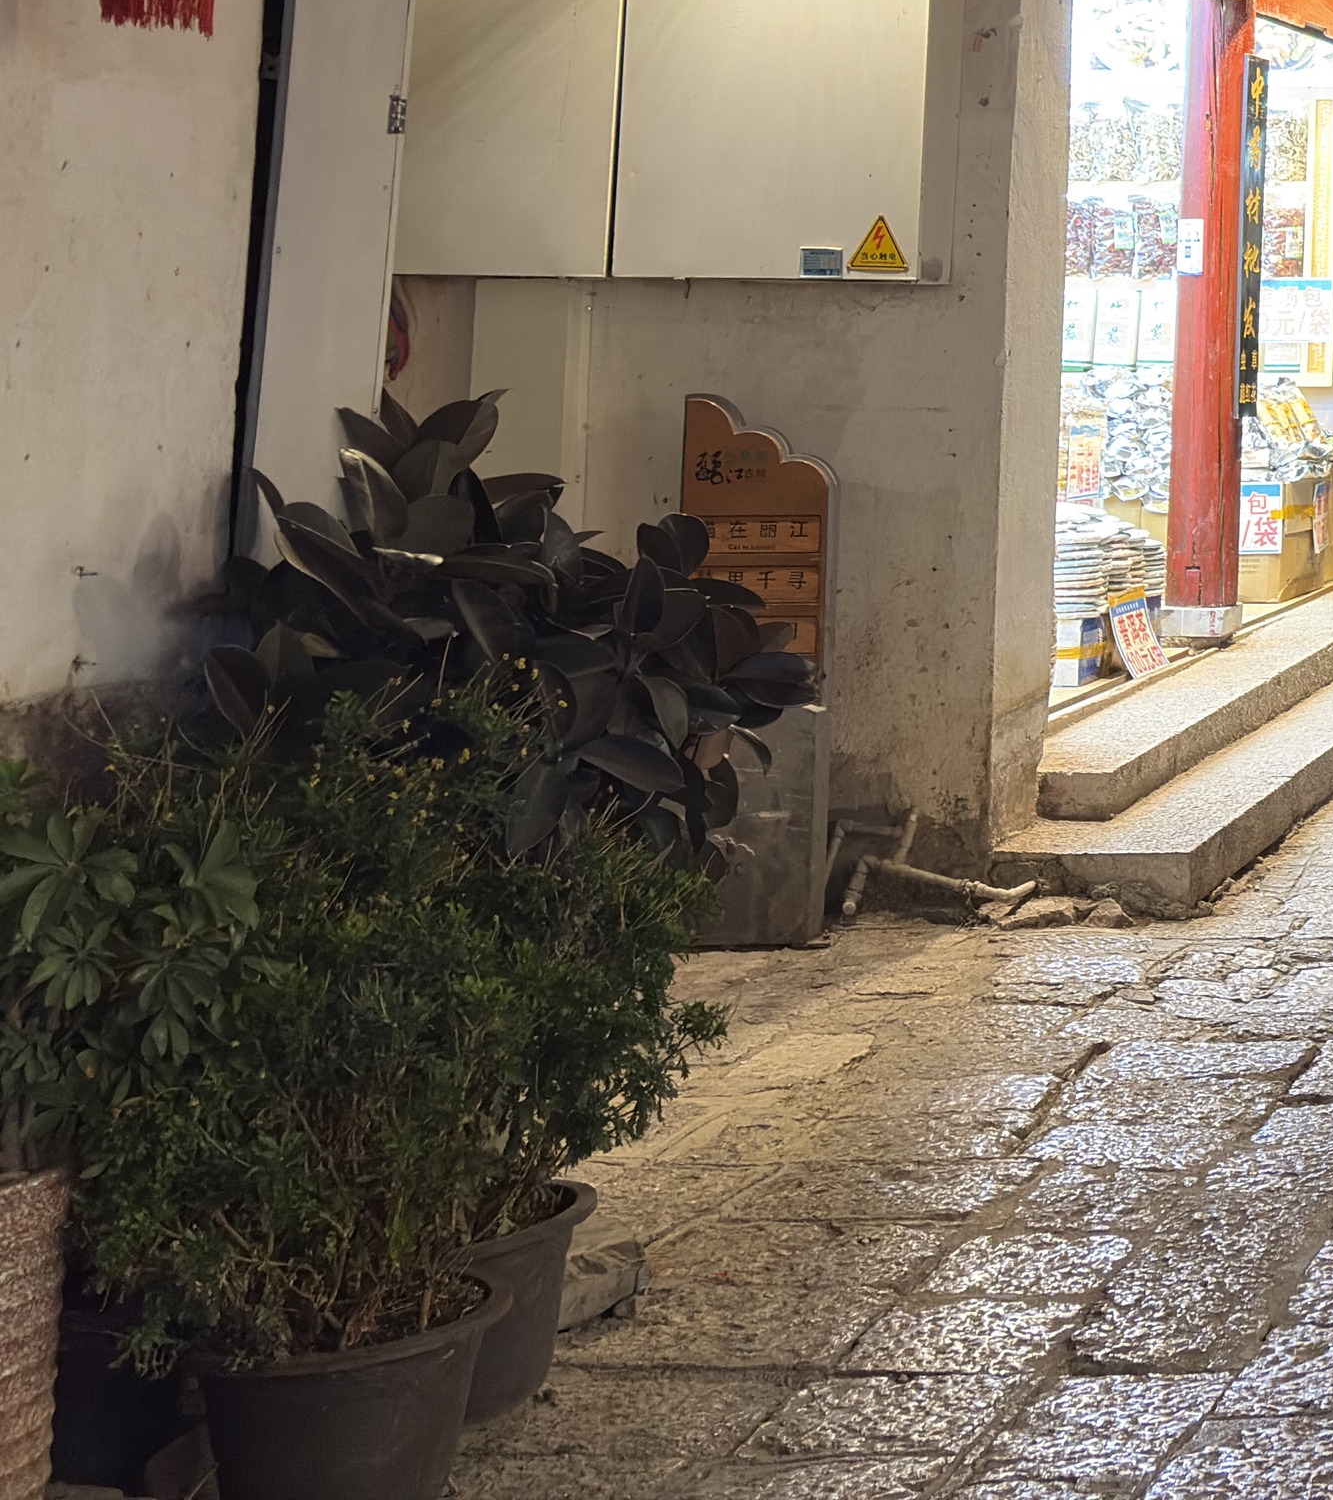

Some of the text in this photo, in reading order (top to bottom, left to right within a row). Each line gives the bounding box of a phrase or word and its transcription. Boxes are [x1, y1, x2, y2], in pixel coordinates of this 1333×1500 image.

[1248, 492, 1269, 515] 包
[702, 570, 807, 590] 里千寻
[1117, 610, 1151, 648] 普洱茶
